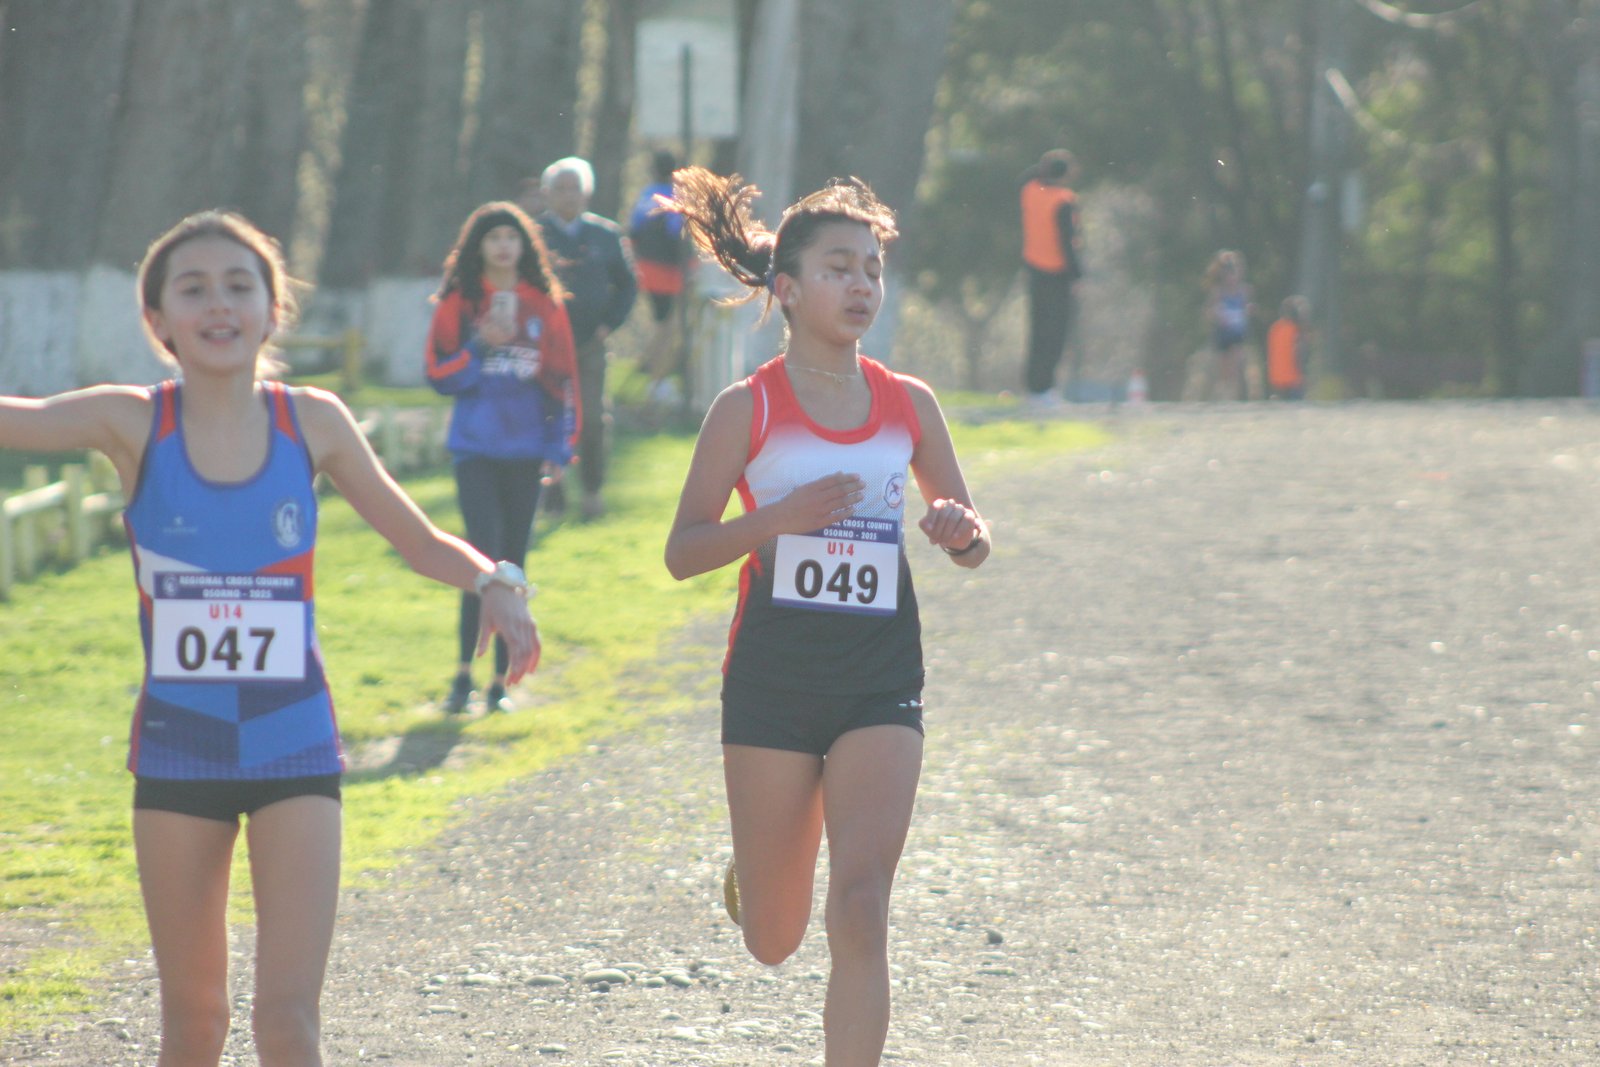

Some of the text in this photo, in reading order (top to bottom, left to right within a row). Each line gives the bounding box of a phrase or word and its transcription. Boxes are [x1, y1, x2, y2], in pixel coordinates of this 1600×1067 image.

[842, 519, 865, 528] CROSS
[867, 522, 893, 531] COUNTRY
[823, 529, 854, 538] OSORNO
[861, 532, 877, 541] 2025
[827, 542, 855, 556] U14
[179, 576, 295, 586] REGIONAL CROSS COUNTRY
[795, 559, 878, 604] 049
[203, 589, 240, 598] OSORNO
[209, 604, 243, 619] U14
[176, 626, 276, 672] 047
